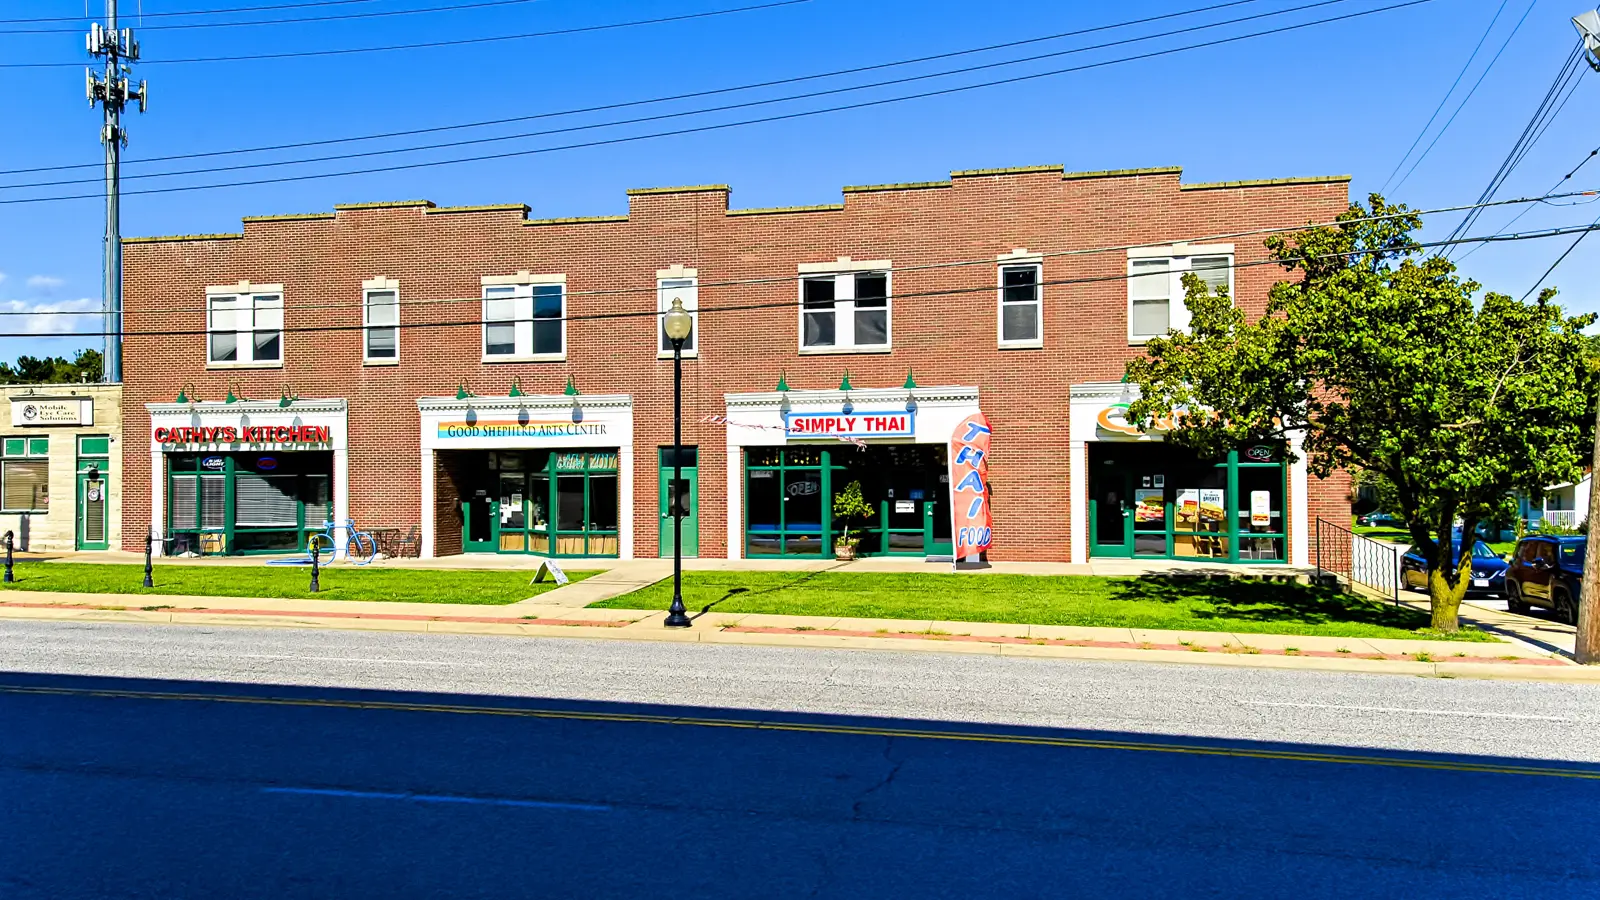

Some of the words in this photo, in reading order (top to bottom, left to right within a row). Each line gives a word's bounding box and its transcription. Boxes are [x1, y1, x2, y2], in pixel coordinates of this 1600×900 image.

[448, 425, 479, 437] GOOD
[483, 425, 536, 437] SHEPHERD
[538, 425, 564, 436] ARTS
[566, 424, 607, 435] CENTER
[794, 417, 856, 433] SIMPLY
[863, 416, 905, 431] THAI
[154, 426, 236, 444] CATHY'S
[242, 426, 329, 443] KITCHEN
[1247, 448, 1270, 456] OPEN
[954, 421, 992, 519] THAI
[790, 481, 817, 496] OPEN
[959, 526, 991, 547] FOOD
